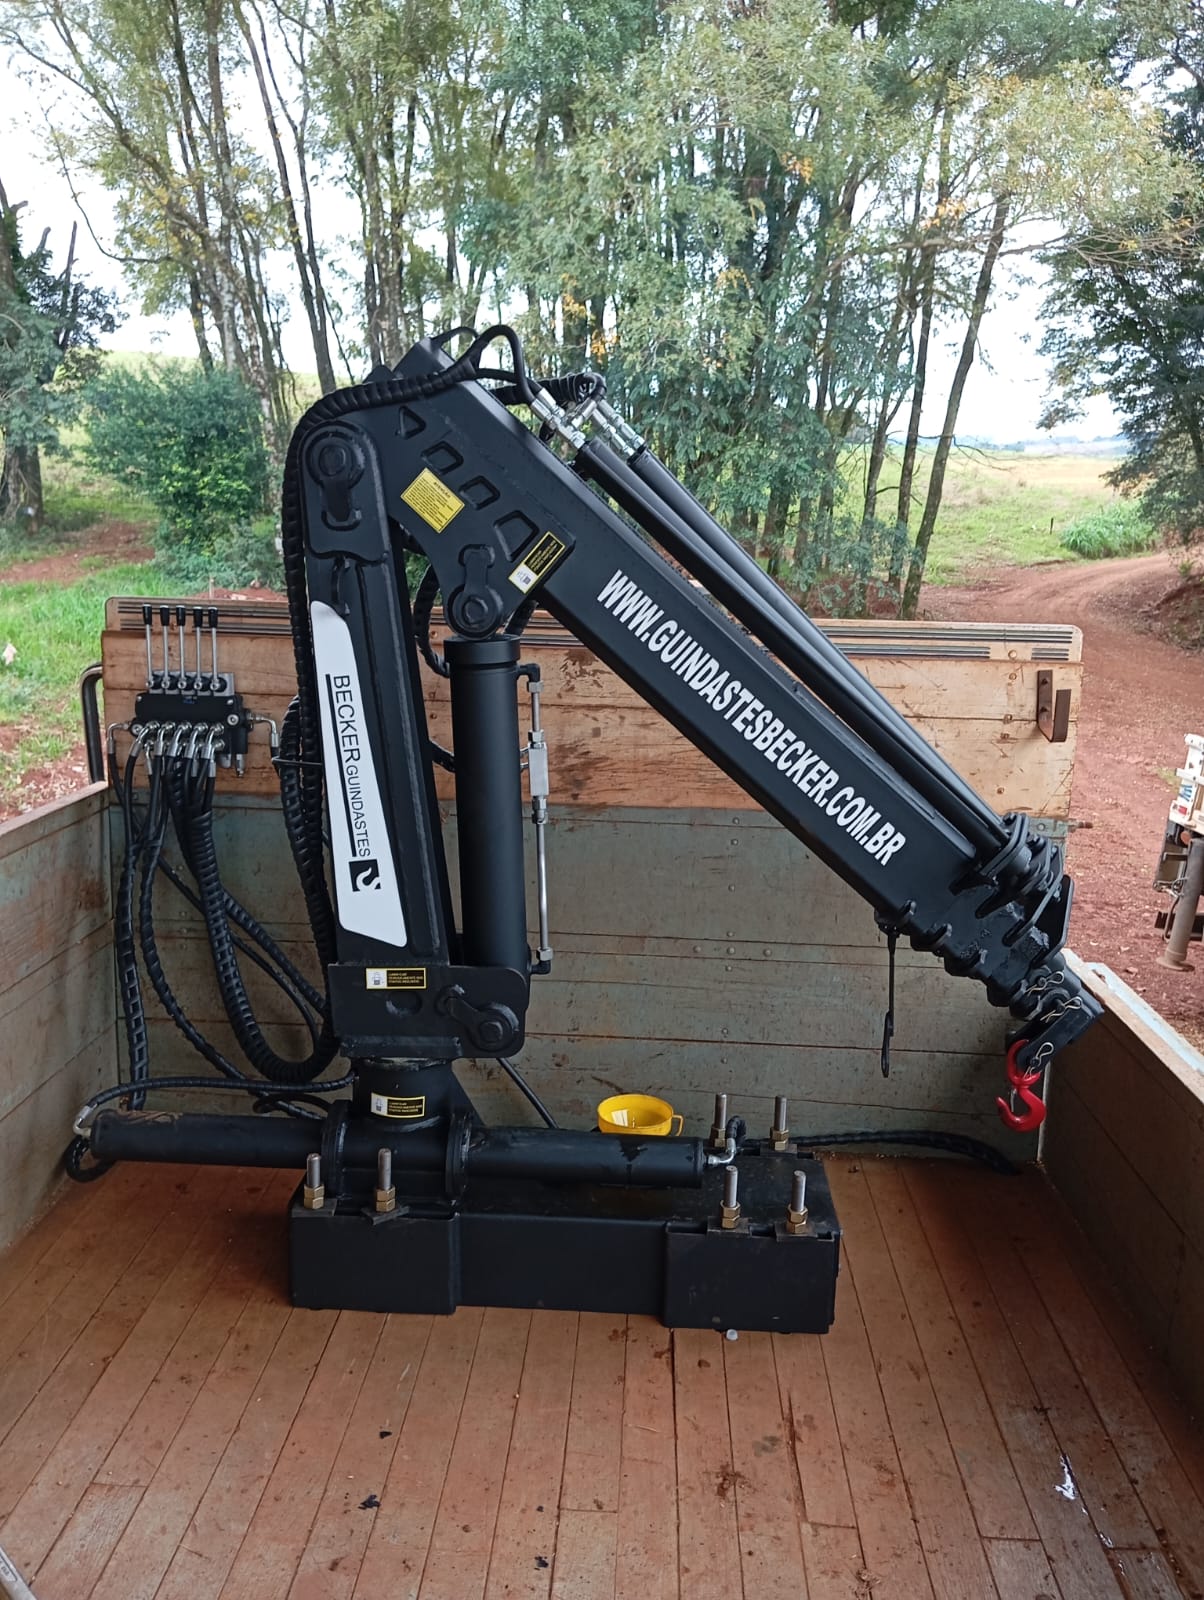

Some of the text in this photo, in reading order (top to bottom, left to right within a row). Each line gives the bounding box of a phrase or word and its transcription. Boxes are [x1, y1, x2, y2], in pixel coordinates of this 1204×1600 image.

[333, 675, 371, 857] BECKER GUINDASTES
[597, 569, 907, 866] WWW.GUINDASTESBECKER.COM.BR
